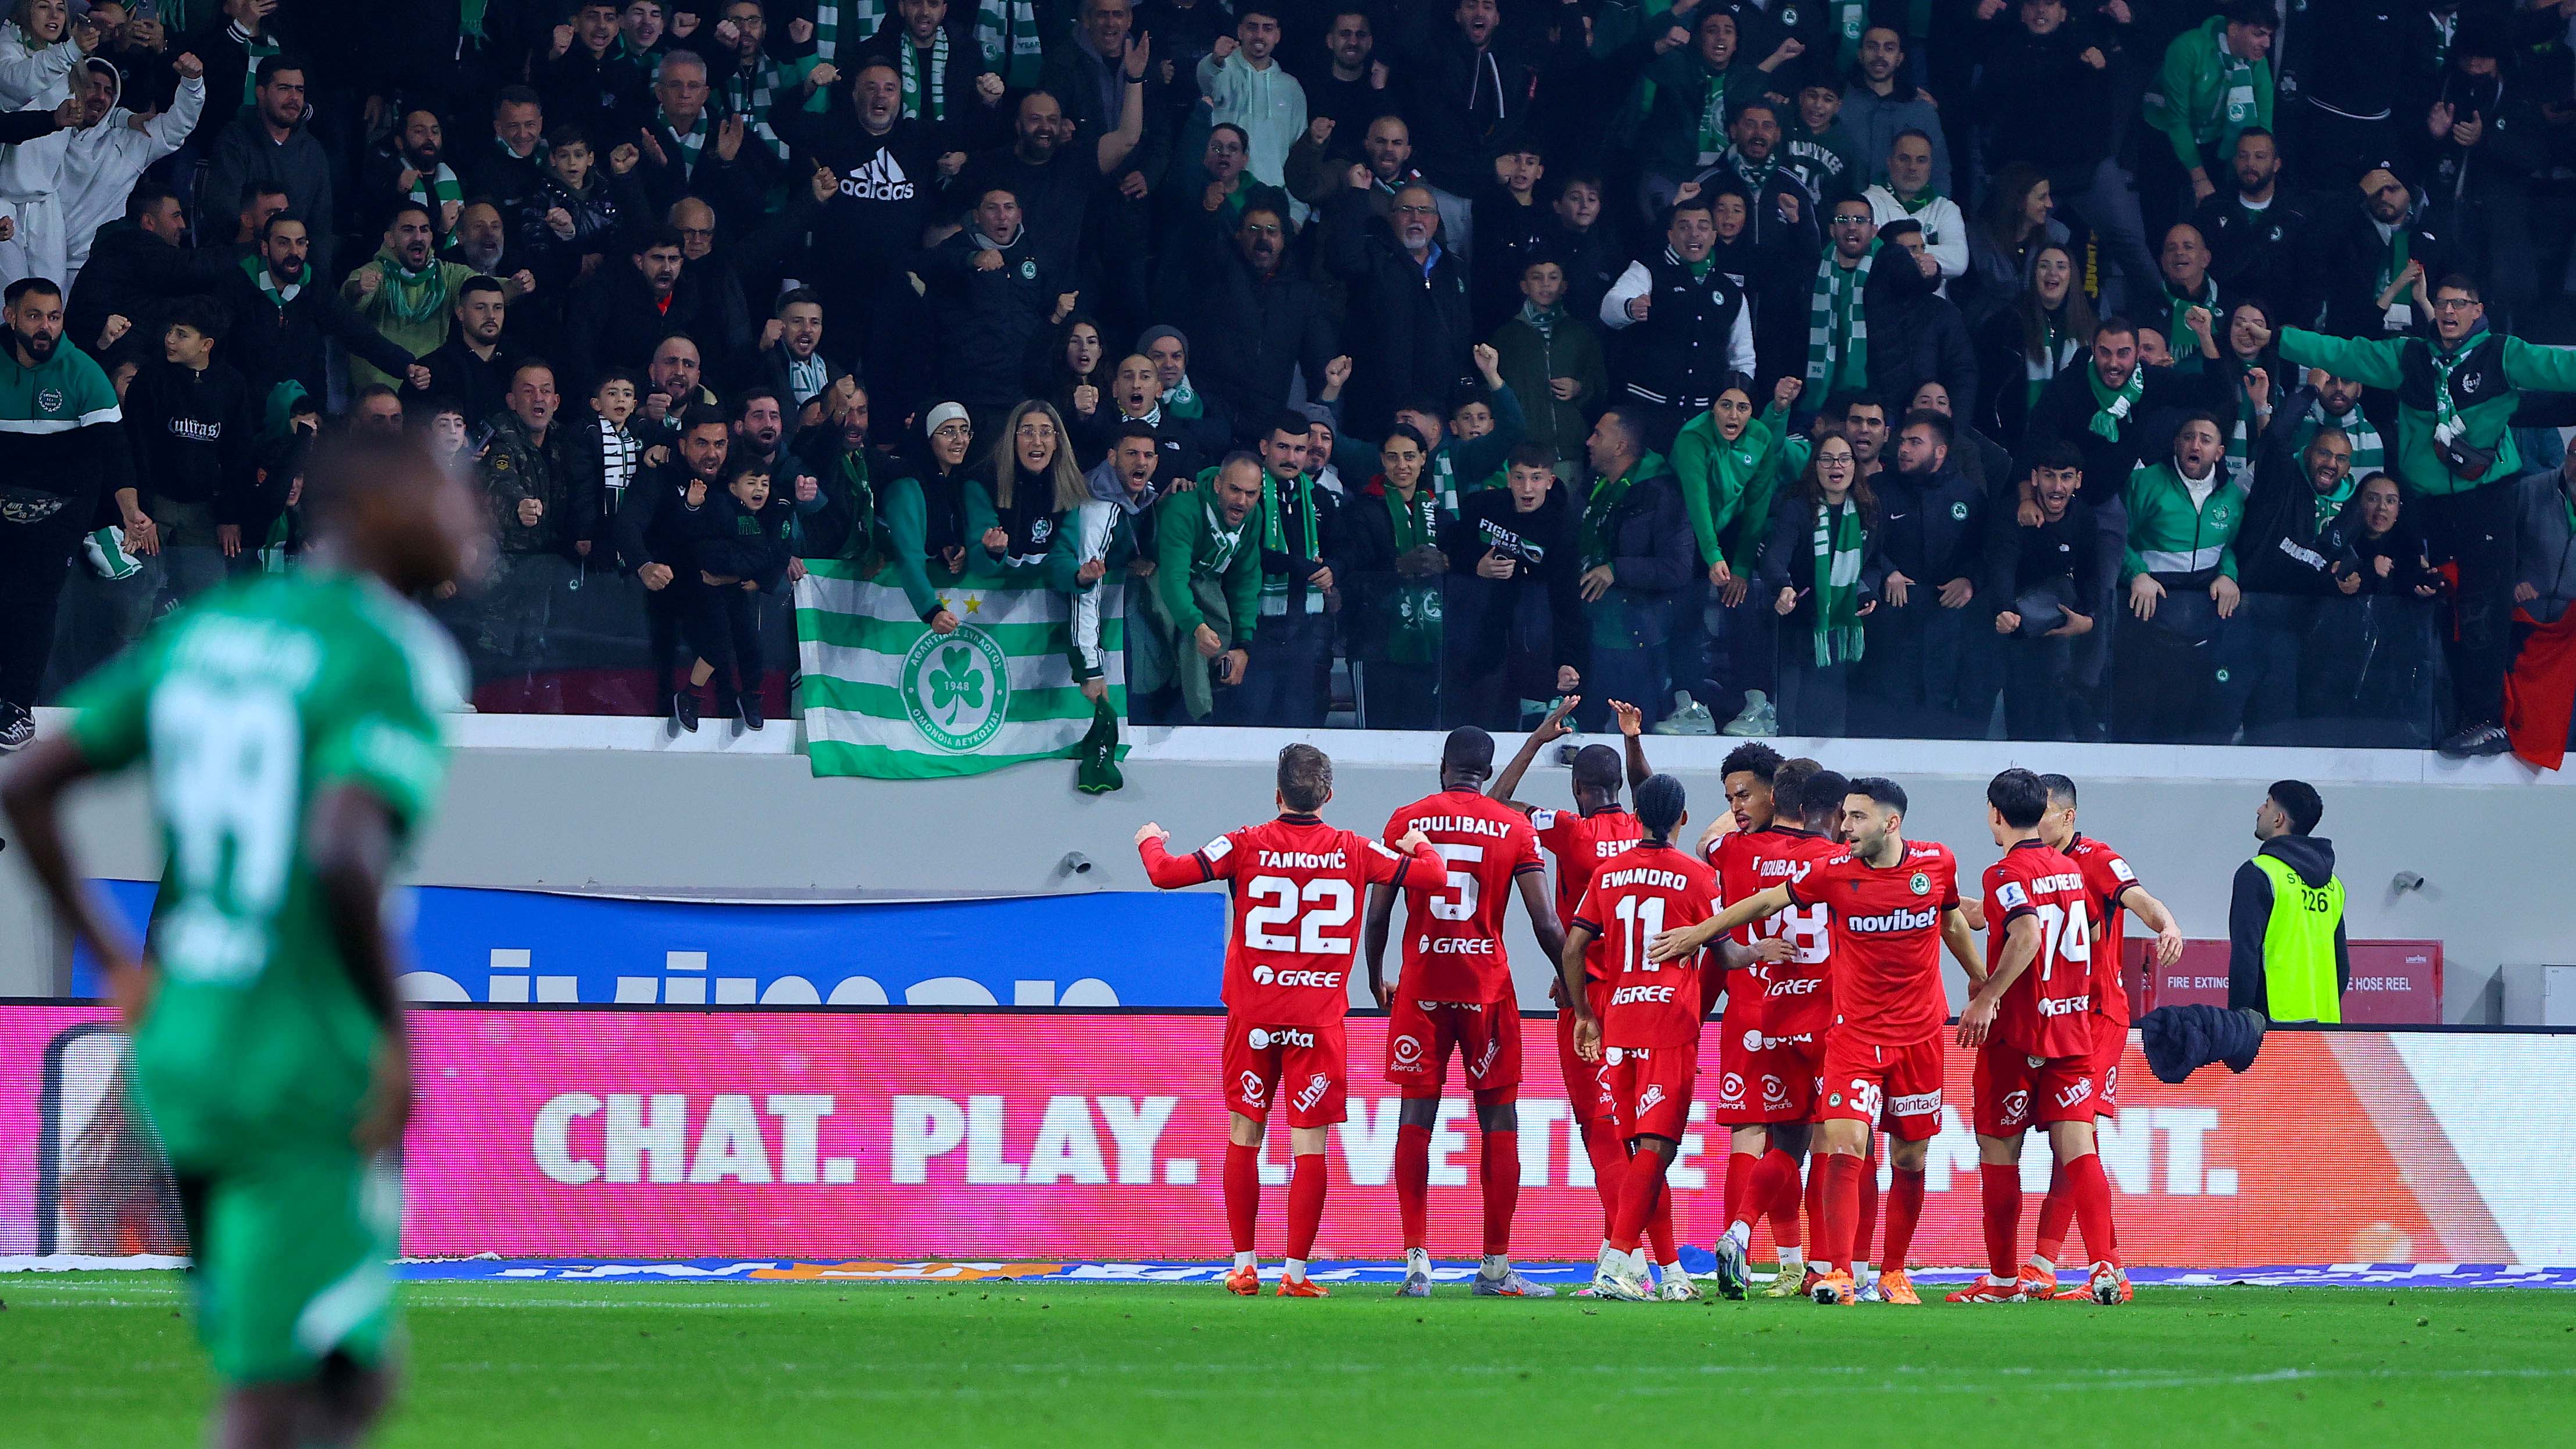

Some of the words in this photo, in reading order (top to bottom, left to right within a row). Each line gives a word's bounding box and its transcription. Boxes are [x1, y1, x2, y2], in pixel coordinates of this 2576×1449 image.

[840, 179, 914, 201] adidas
[1480, 518, 1519, 543] FIGHT
[944, 681, 969, 691] 1948
[1408, 816, 1511, 839] COULIBALY
[1259, 847, 1347, 870] TANKOVIĆ
[1430, 844, 1484, 921] 5
[1600, 868, 1688, 891] EWANDRO
[1245, 875, 1355, 954] 22
[1849, 906, 1937, 932] novibet
[1615, 895, 1665, 973] 11
[2036, 899, 2091, 982] 74
[1432, 938, 1494, 955] GREE
[1277, 970, 1342, 988] GREE
[2167, 976, 2190, 988] FIRE
[2356, 977, 2384, 991] HOSE
[2385, 977, 2412, 991] REEL
[1270, 1028, 1314, 1048] cyta
[1292, 1076, 1327, 1113] Line
[1850, 1078, 1882, 1116] 30
[1891, 1095, 1939, 1112] Jointace
[2055, 1078, 2091, 1108] Line
[531, 1091, 857, 1186] CHAT.
[891, 1095, 1199, 1184] PLAY.
[1258, 1096, 1468, 1186] VE
